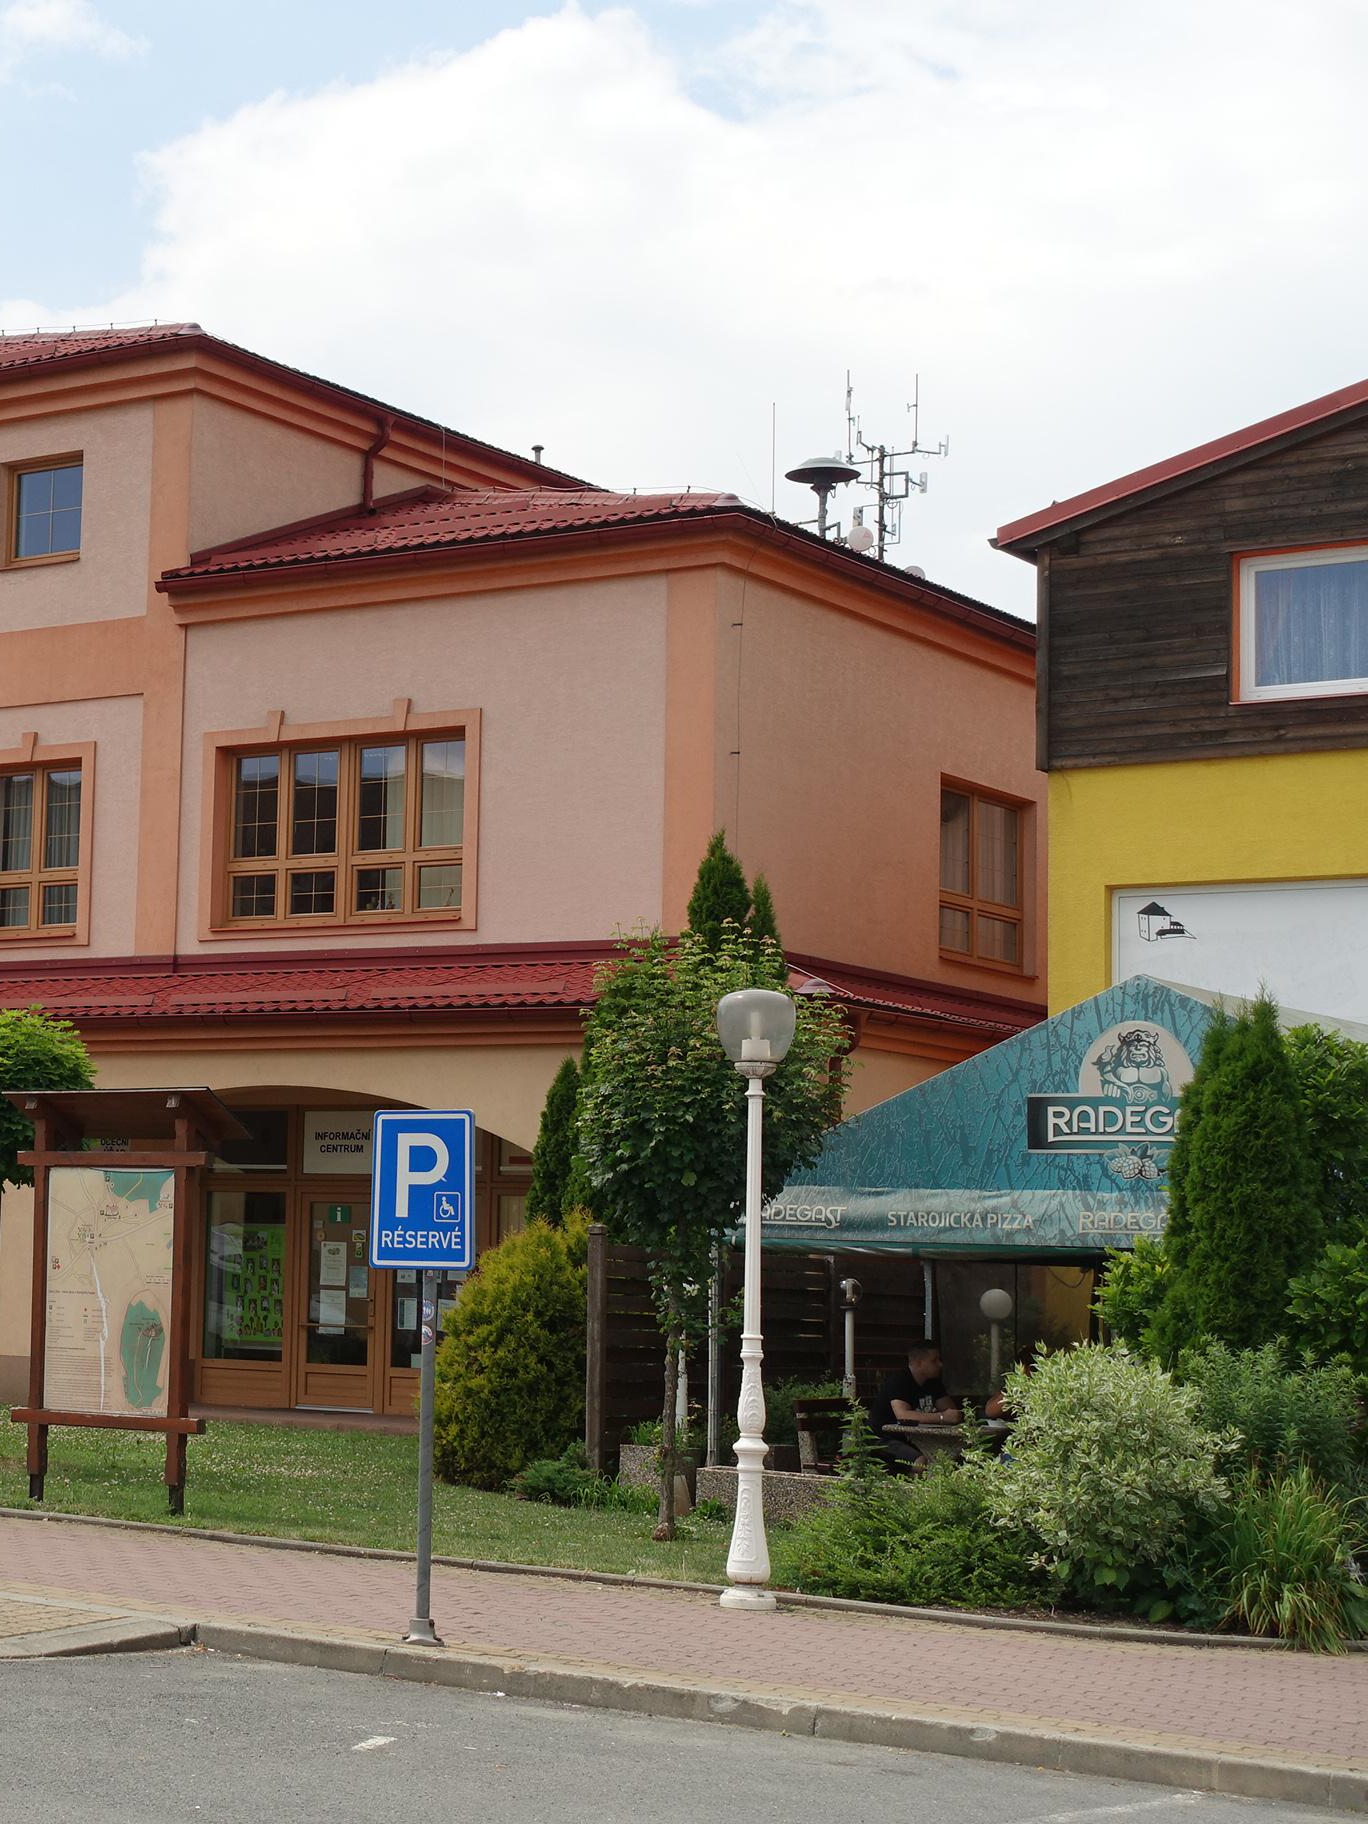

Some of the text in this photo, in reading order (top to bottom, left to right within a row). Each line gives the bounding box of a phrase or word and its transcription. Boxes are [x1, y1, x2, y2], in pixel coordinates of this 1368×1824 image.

[314, 1128, 371, 1141] INFORMAČNÍ
[1047, 1105, 1181, 1142] RADEG
[319, 1144, 364, 1153] CENTRUM
[396, 1133, 449, 1217] P
[761, 1204, 848, 1229] ADEGAST
[887, 1209, 1033, 1230] STAROJICKÁ PIZZA
[1079, 1211, 1170, 1233] RADEGA
[381, 1225, 462, 1249] RÉSERVÉ
